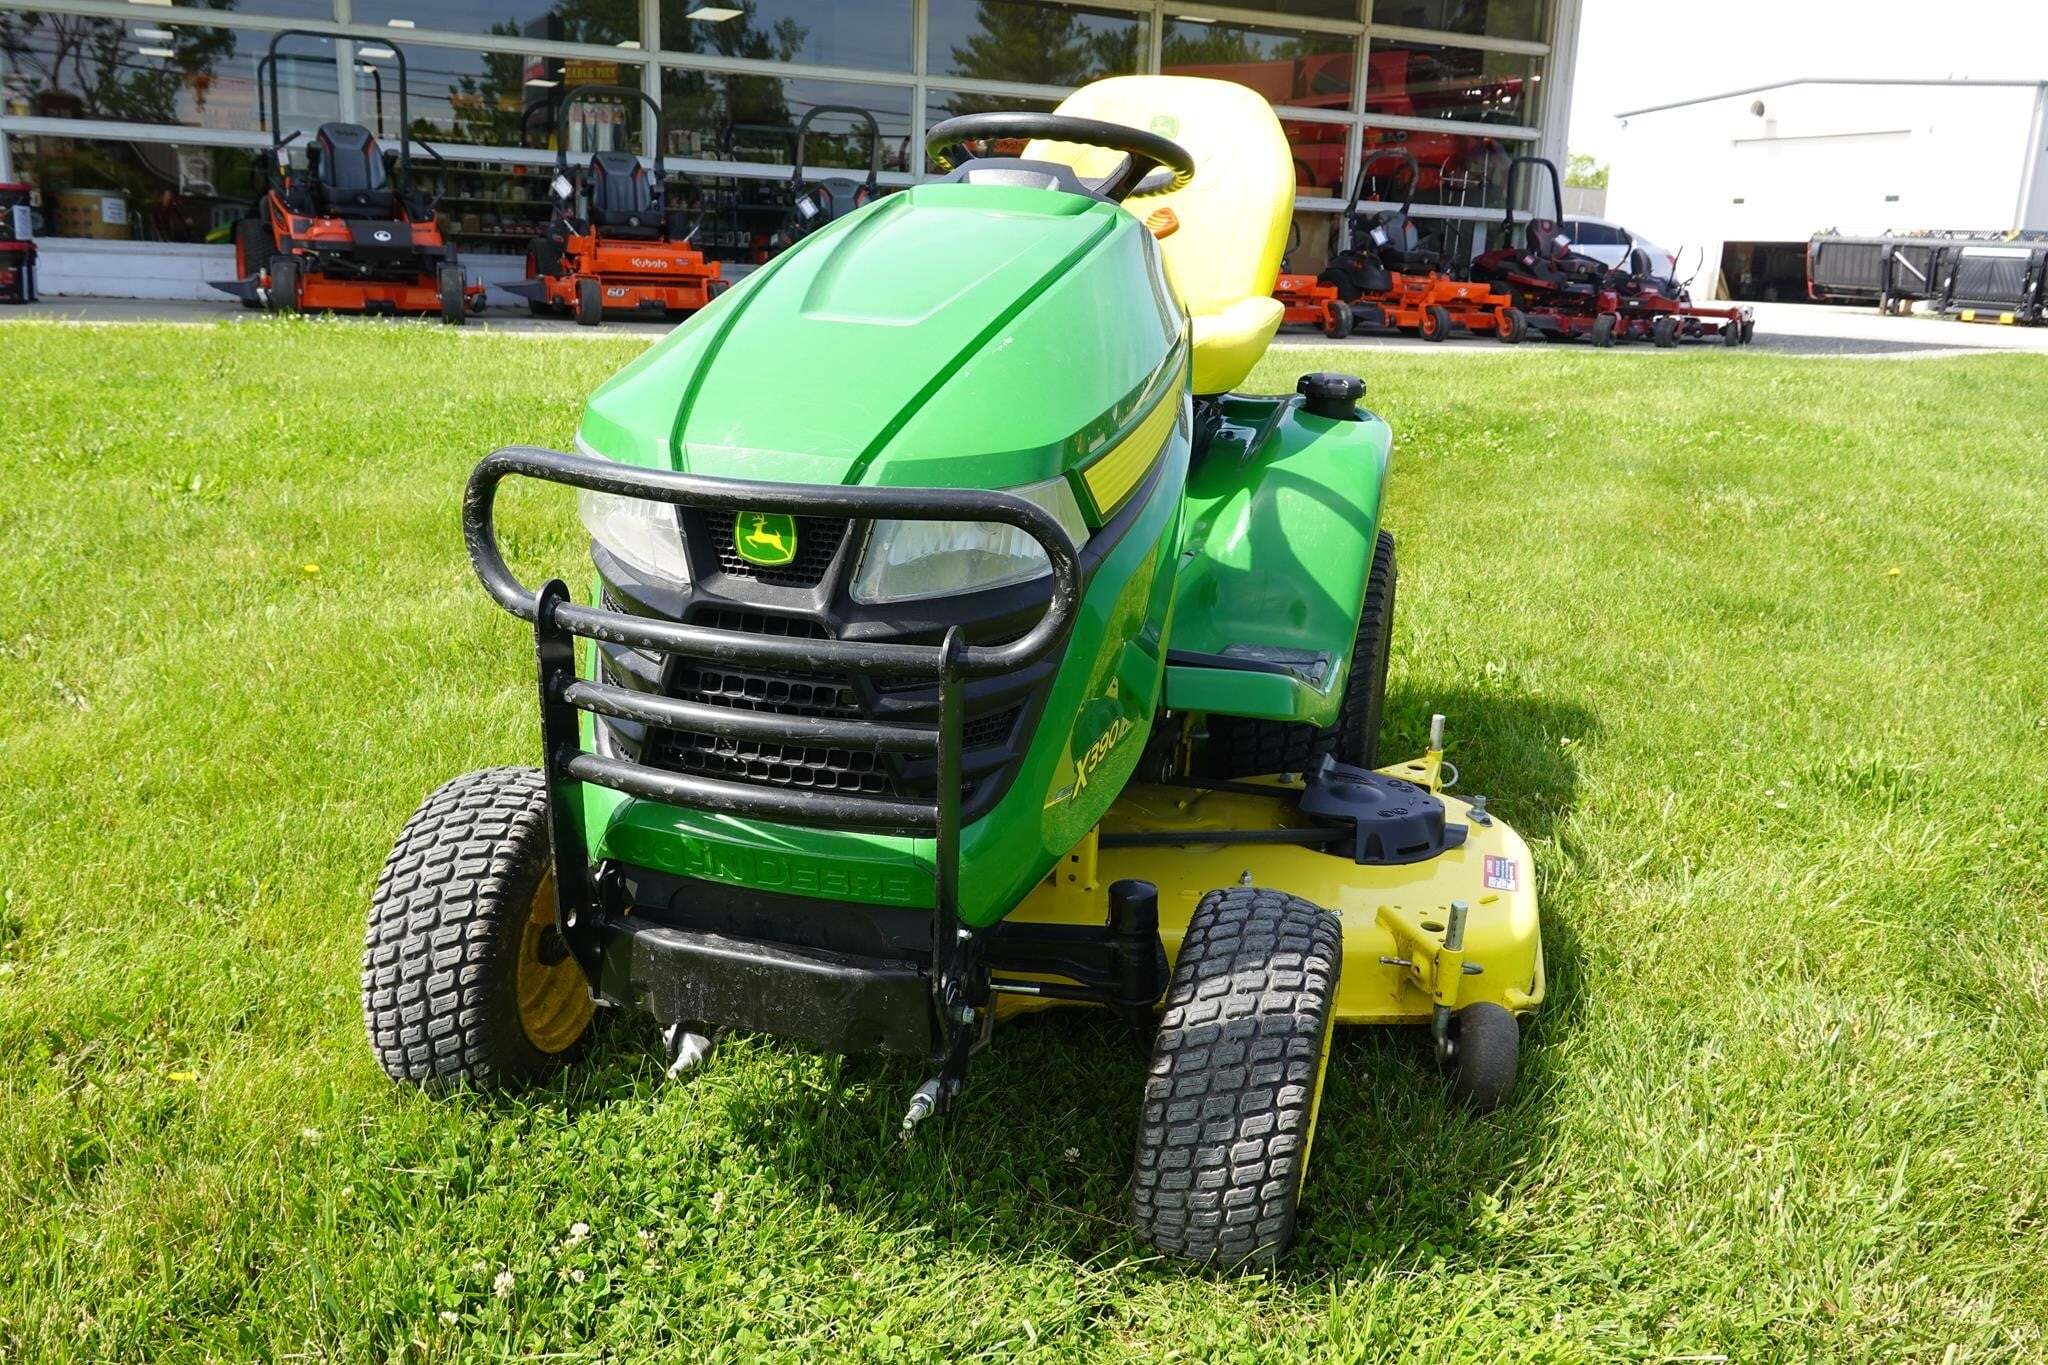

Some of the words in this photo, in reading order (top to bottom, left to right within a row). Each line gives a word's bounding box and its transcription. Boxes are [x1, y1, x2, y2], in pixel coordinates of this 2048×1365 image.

[631, 257, 668, 269] Kubota
[1071, 719, 1120, 800] X390
[754, 852, 911, 901] DEERE
